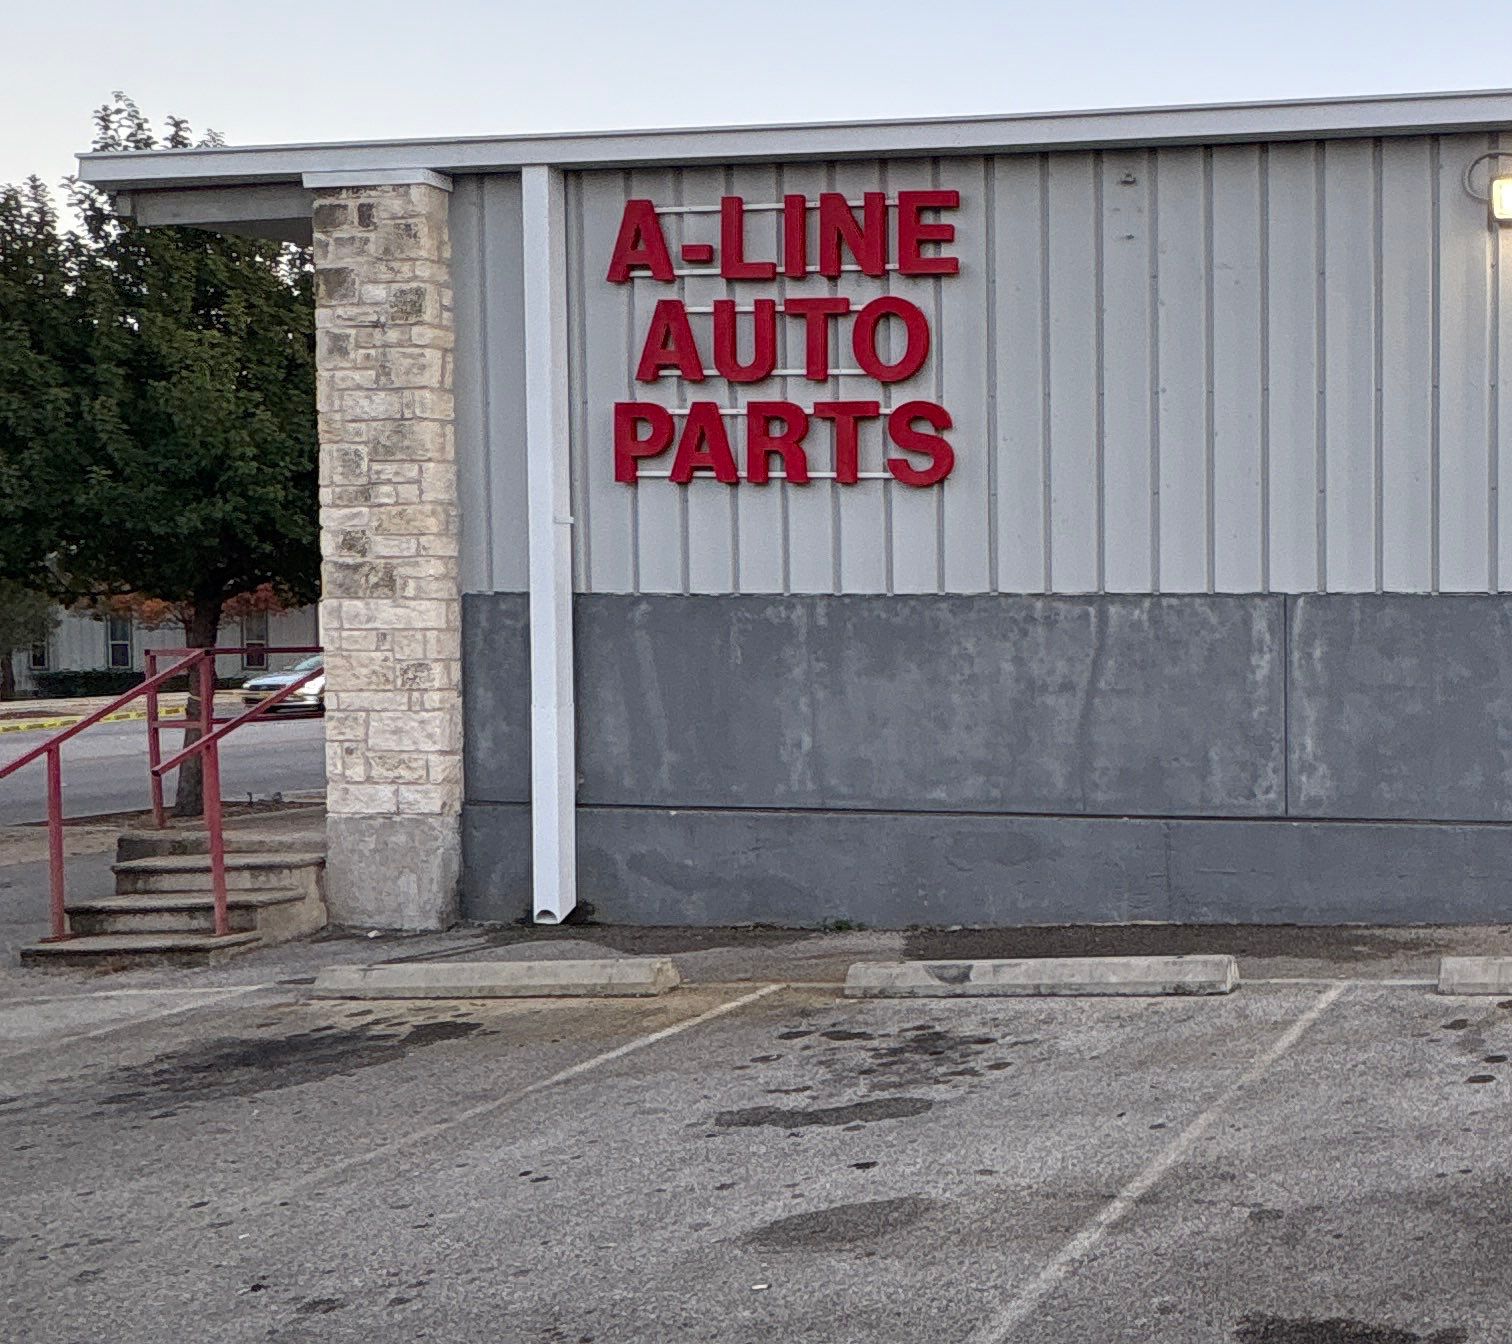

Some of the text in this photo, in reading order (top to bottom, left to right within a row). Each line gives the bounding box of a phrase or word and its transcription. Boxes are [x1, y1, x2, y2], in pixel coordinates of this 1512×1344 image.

[607, 190, 960, 283] A-LINE
[636, 296, 930, 383] AUTO
[614, 401, 955, 487] PARTS
